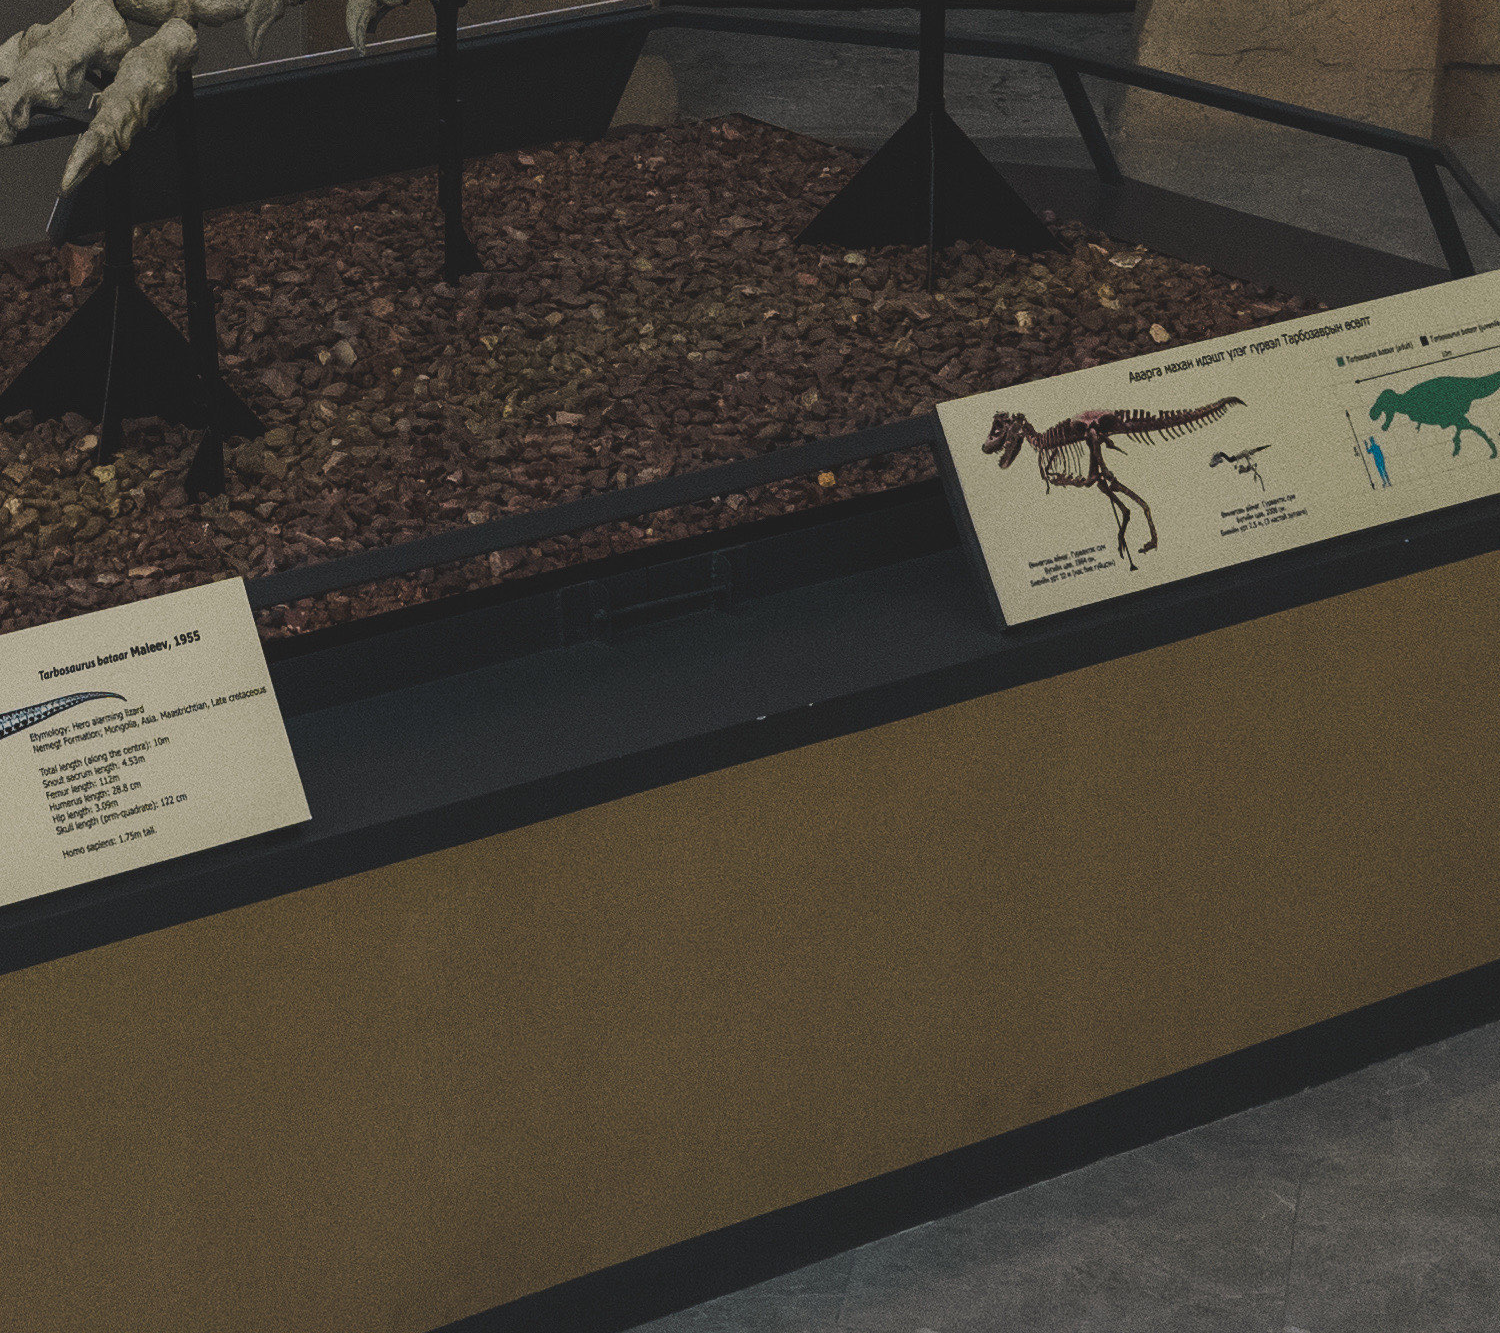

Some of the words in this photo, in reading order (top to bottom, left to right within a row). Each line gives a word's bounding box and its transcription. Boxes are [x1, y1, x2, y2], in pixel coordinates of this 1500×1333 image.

[1128, 366, 1163, 383] Аварга
[1163, 360, 1194, 374] махан
[1195, 351, 1225, 367] идэшт
[1225, 345, 1247, 361] үлэг
[1249, 337, 1281, 354] гүрвэл
[1281, 323, 1343, 345] Тарбозаврын
[1344, 315, 1370, 331] өсөлт
[38, 659, 96, 680] Tarbosaurus
[129, 640, 172, 657] Maleev,
[173, 629, 201, 646] 1955
[28, 726, 71, 742] Etymology:
[71, 720, 91, 730] Hero
[123, 704, 145, 717] lizard
[32, 738, 62, 753] Nemegt
[210, 696, 227, 707] Late
[228, 686, 267, 702] cretaceous
[38, 764, 58, 776] Total
[58, 758, 82, 772] length
[83, 752, 108, 766] (along
[108, 749, 122, 758] the
[153, 736, 170, 747] 10m
[41, 775, 64, 789] Snout
[121, 755, 145, 766] 4.53m
[45, 787, 69, 799] Femur
[70, 780, 97, 793] length:
[48, 796, 83, 811] Humerus
[111, 782, 129, 795] 28.8
[129, 781, 141, 790] cm
[51, 813, 66, 823] Hip
[94, 799, 119, 812] 3.09m
[55, 822, 74, 835] Skull
[74, 816, 99, 830] length
[160, 795, 175, 807] 122
[175, 793, 188, 803] cm
[61, 846, 85, 859] Homo
[118, 830, 142, 843] 1.75m
